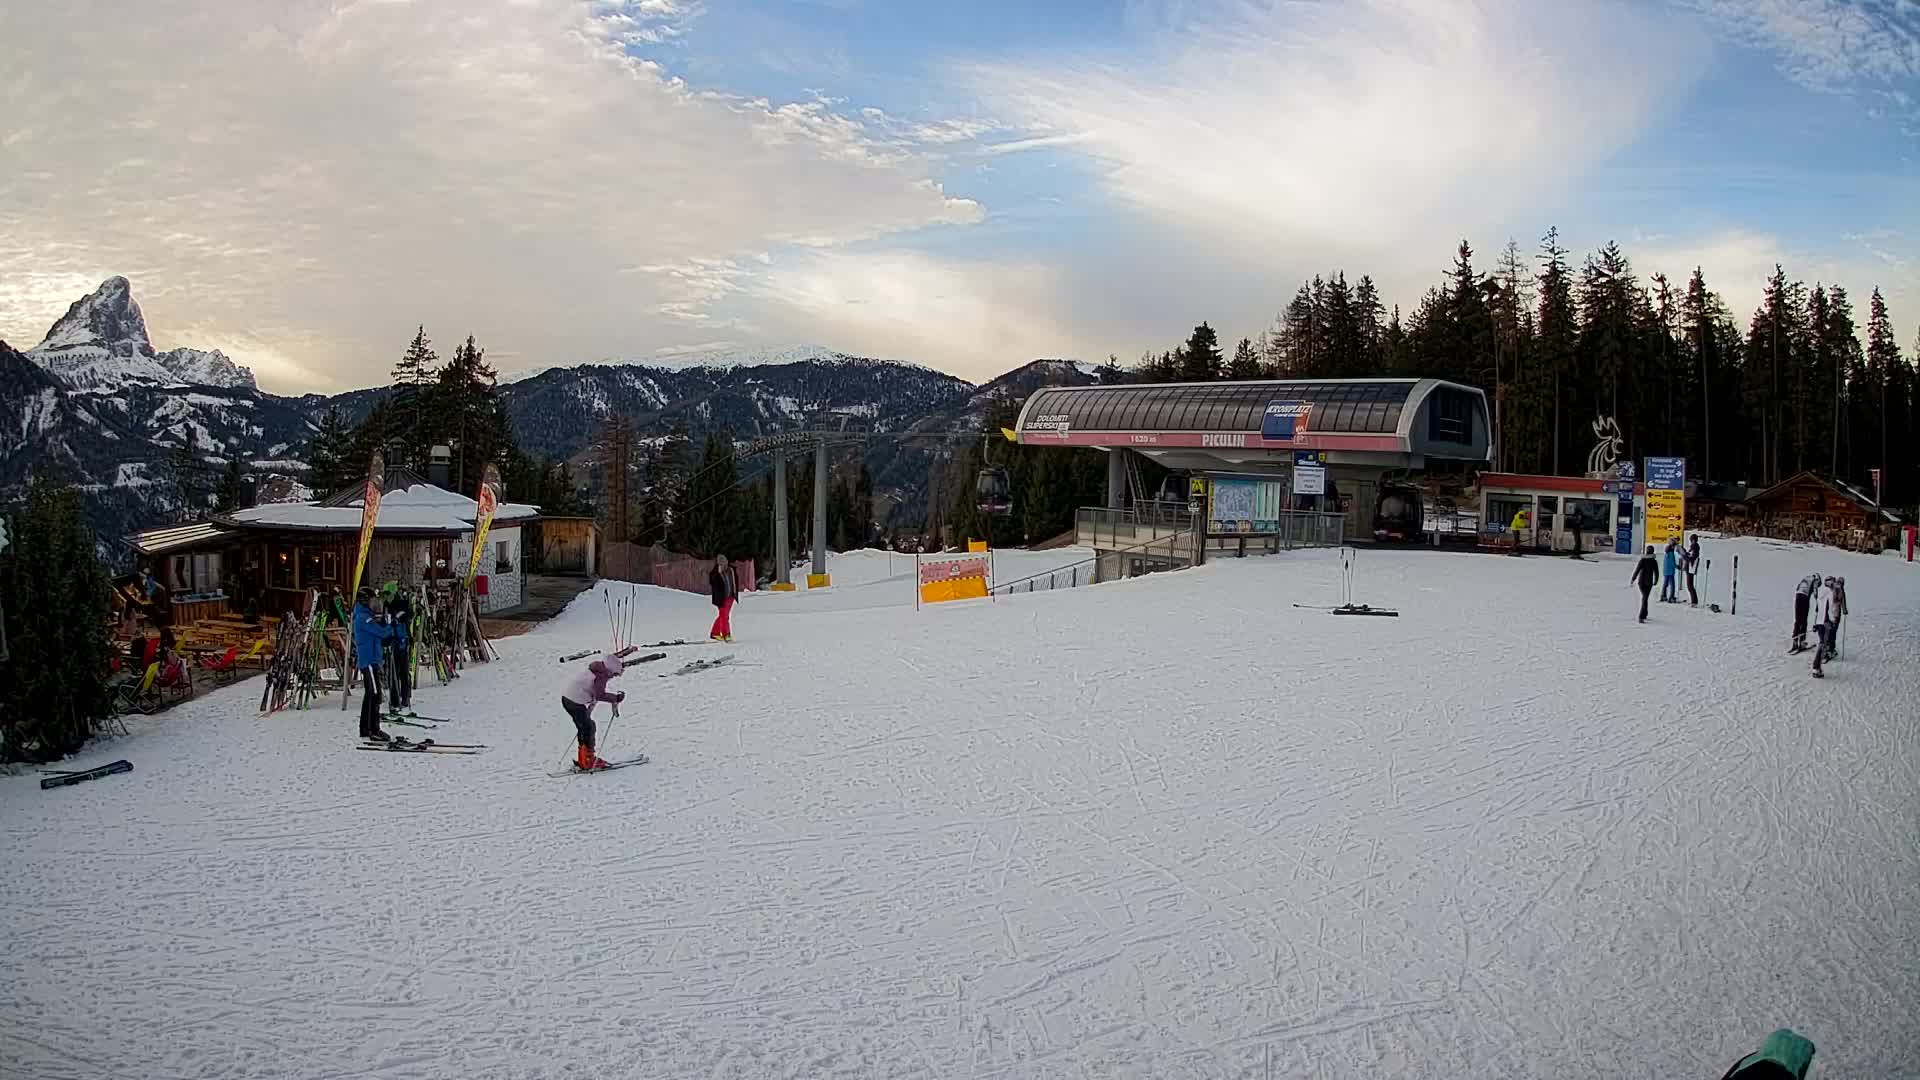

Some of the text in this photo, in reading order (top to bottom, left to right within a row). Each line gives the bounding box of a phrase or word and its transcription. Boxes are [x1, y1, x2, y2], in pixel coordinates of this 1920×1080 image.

[1036, 414, 1069, 422] DOLOMITI
[1026, 422, 1058, 430] SUPERSKI
[1202, 434, 1245, 447] PICULIN
